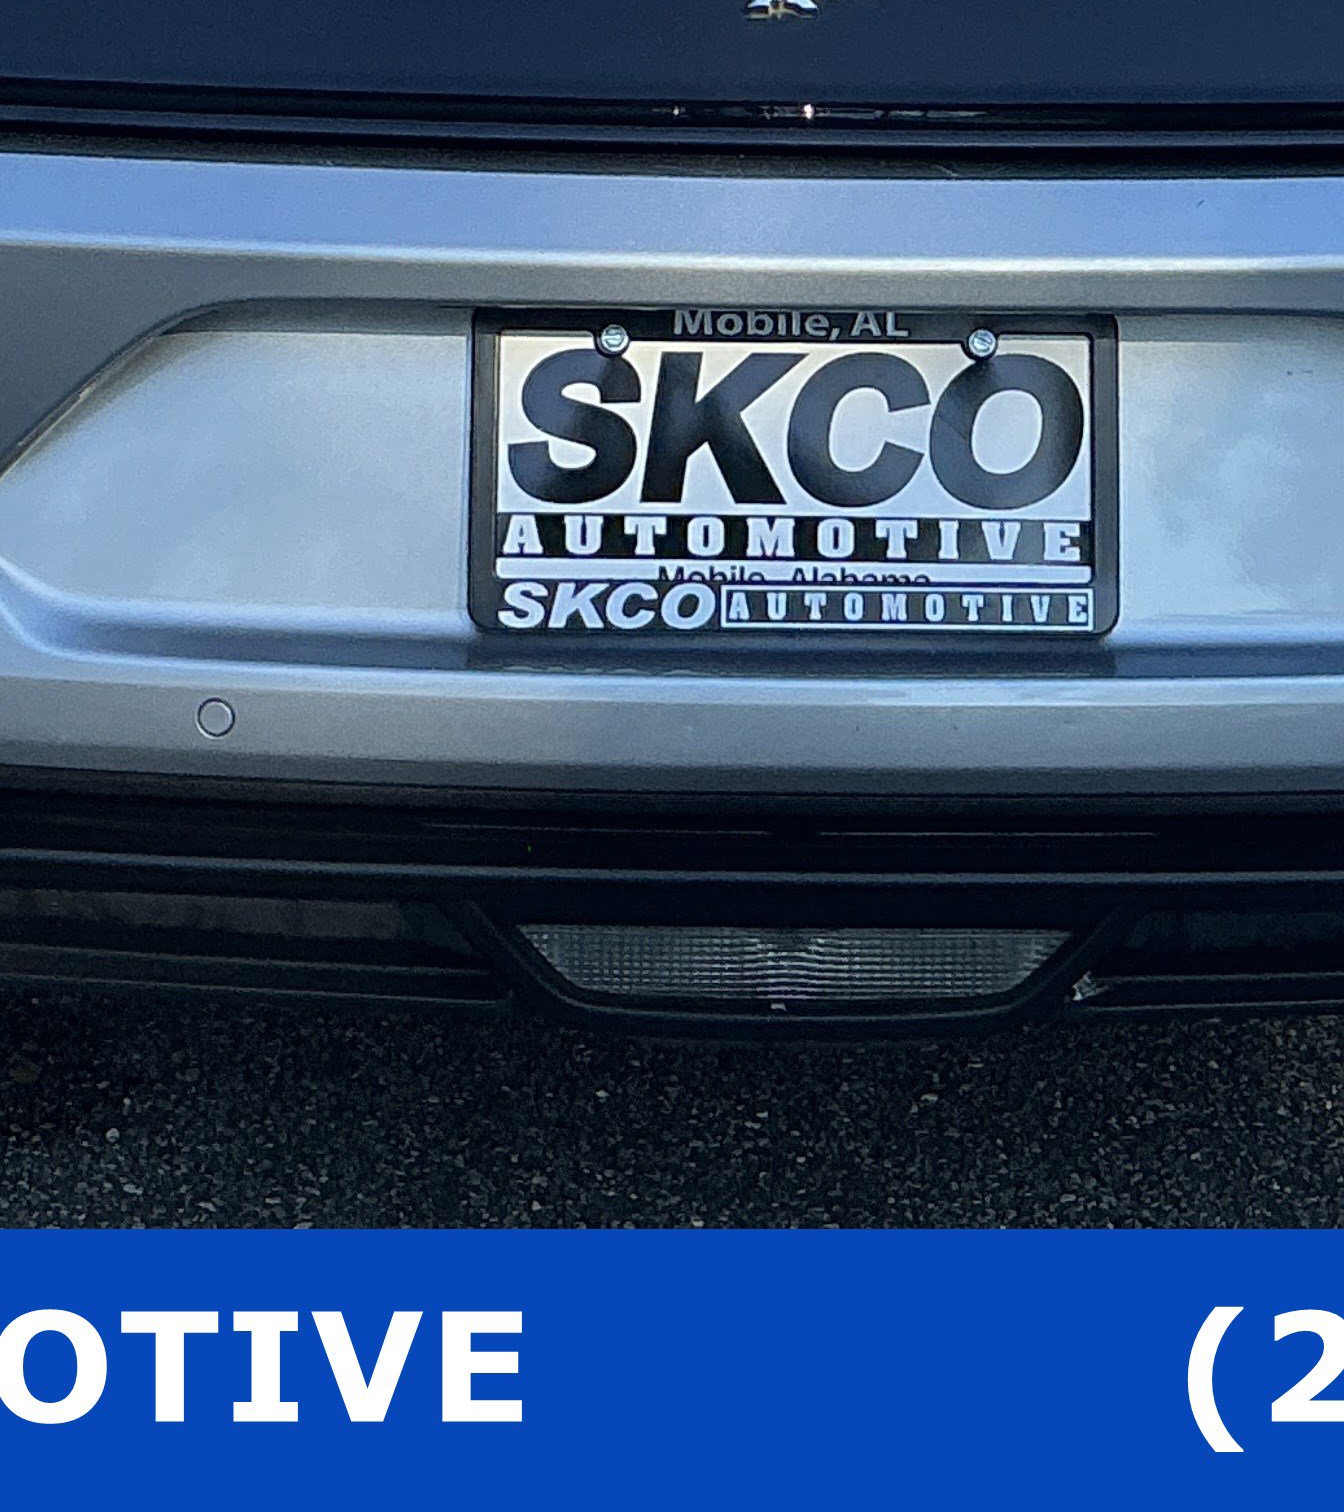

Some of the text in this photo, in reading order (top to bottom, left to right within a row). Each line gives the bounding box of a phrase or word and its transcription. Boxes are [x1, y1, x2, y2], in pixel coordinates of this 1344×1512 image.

[673, 308, 910, 341] Mobile, AL
[507, 347, 1084, 511] SKCO
[501, 513, 1082, 563] AUTOMOTIVE
[498, 580, 717, 631] SKCO
[729, 590, 1089, 624] AUTOMOTIVE
